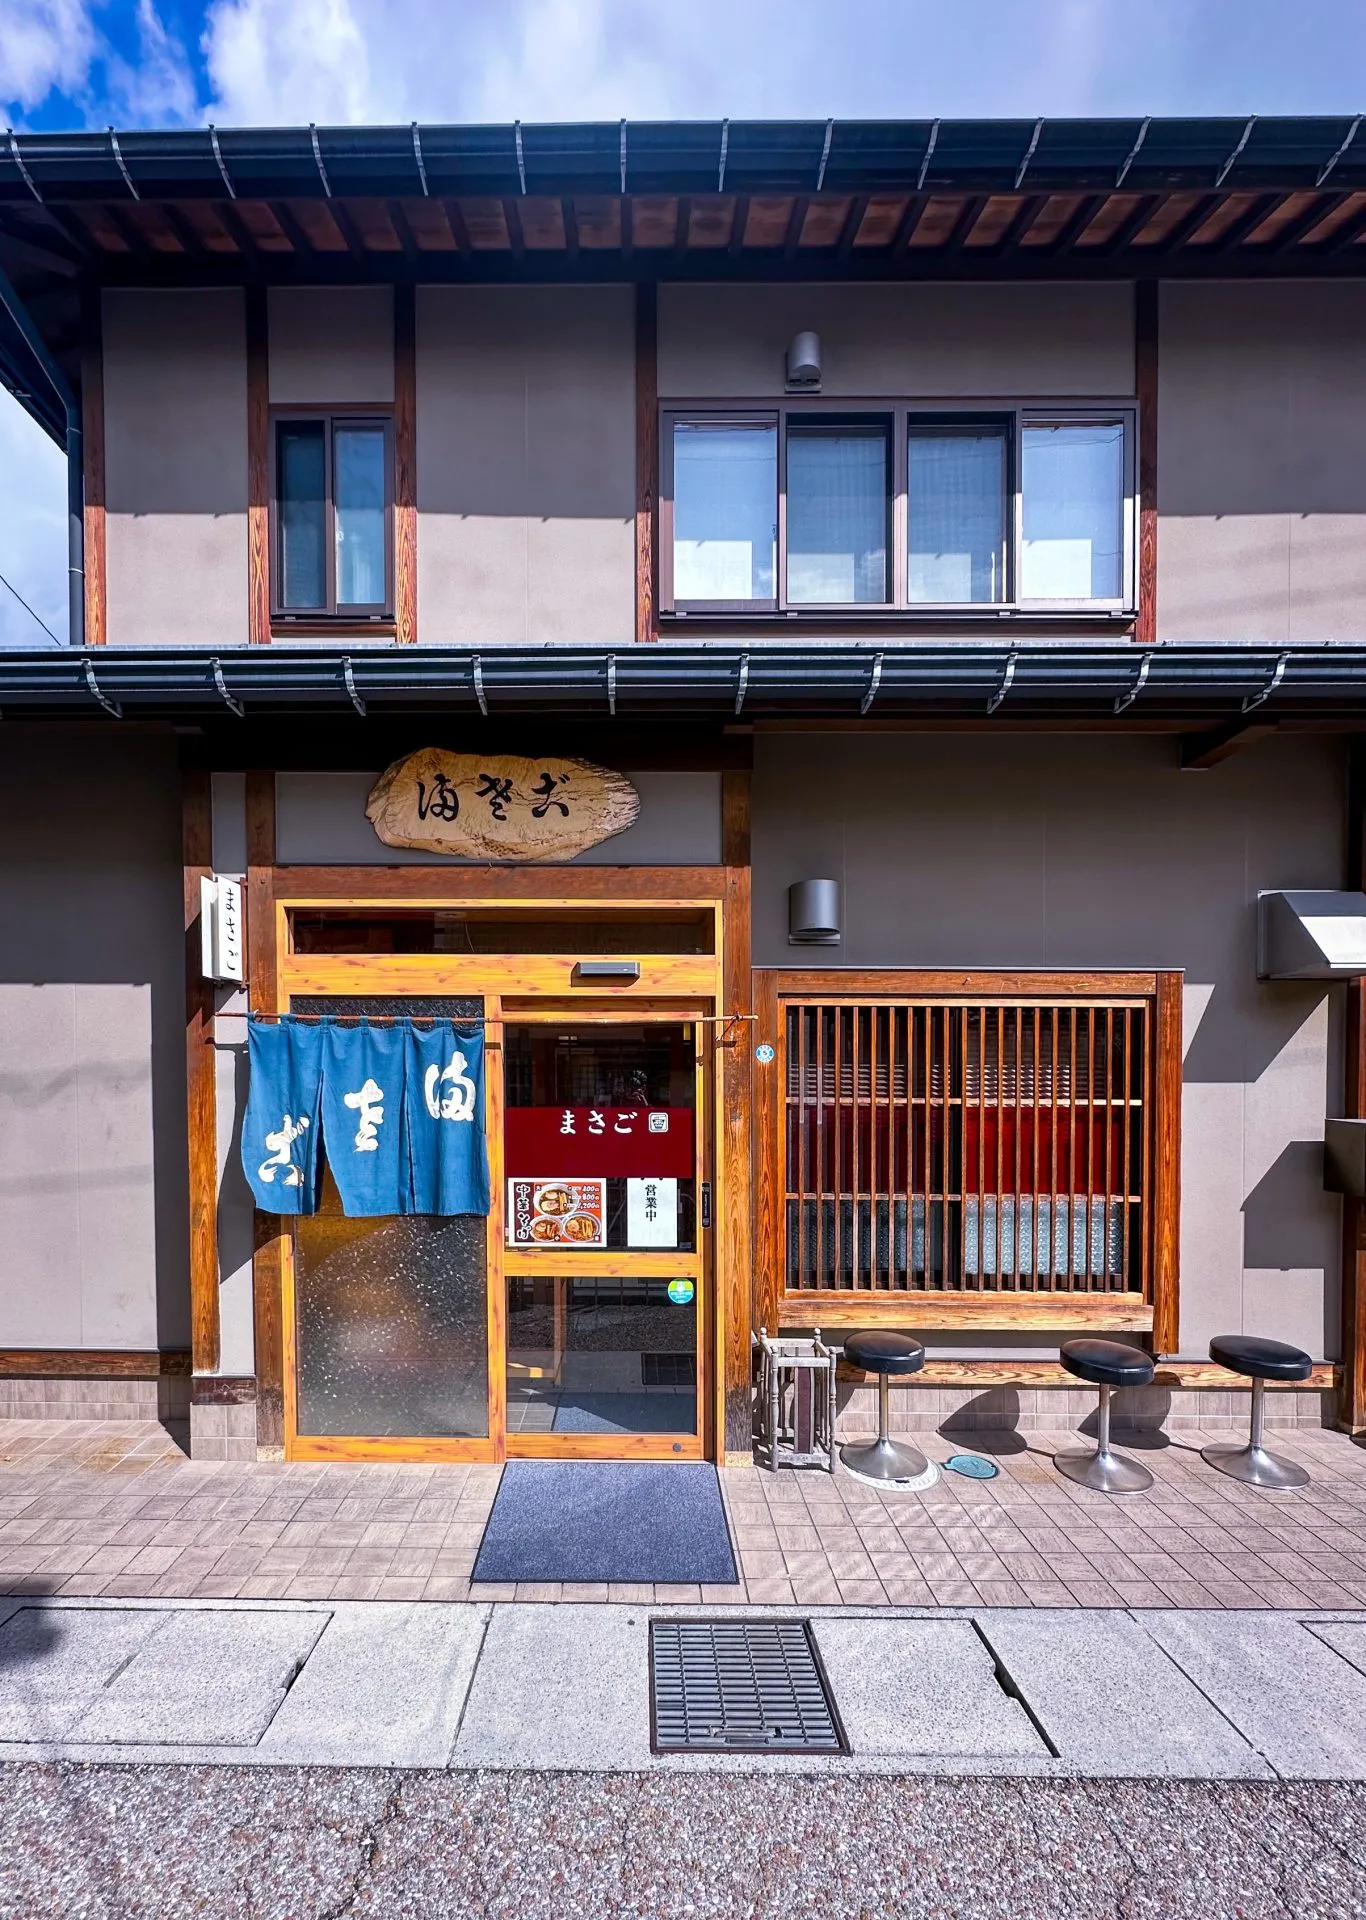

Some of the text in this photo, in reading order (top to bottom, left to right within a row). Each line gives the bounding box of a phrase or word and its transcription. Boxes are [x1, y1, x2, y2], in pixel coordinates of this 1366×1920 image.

[225, 887, 239, 971] まさご
[559, 1109, 638, 1135] まさご
[515, 1183, 532, 1240] 中華そば
[645, 1184, 657, 1222] 営業中
